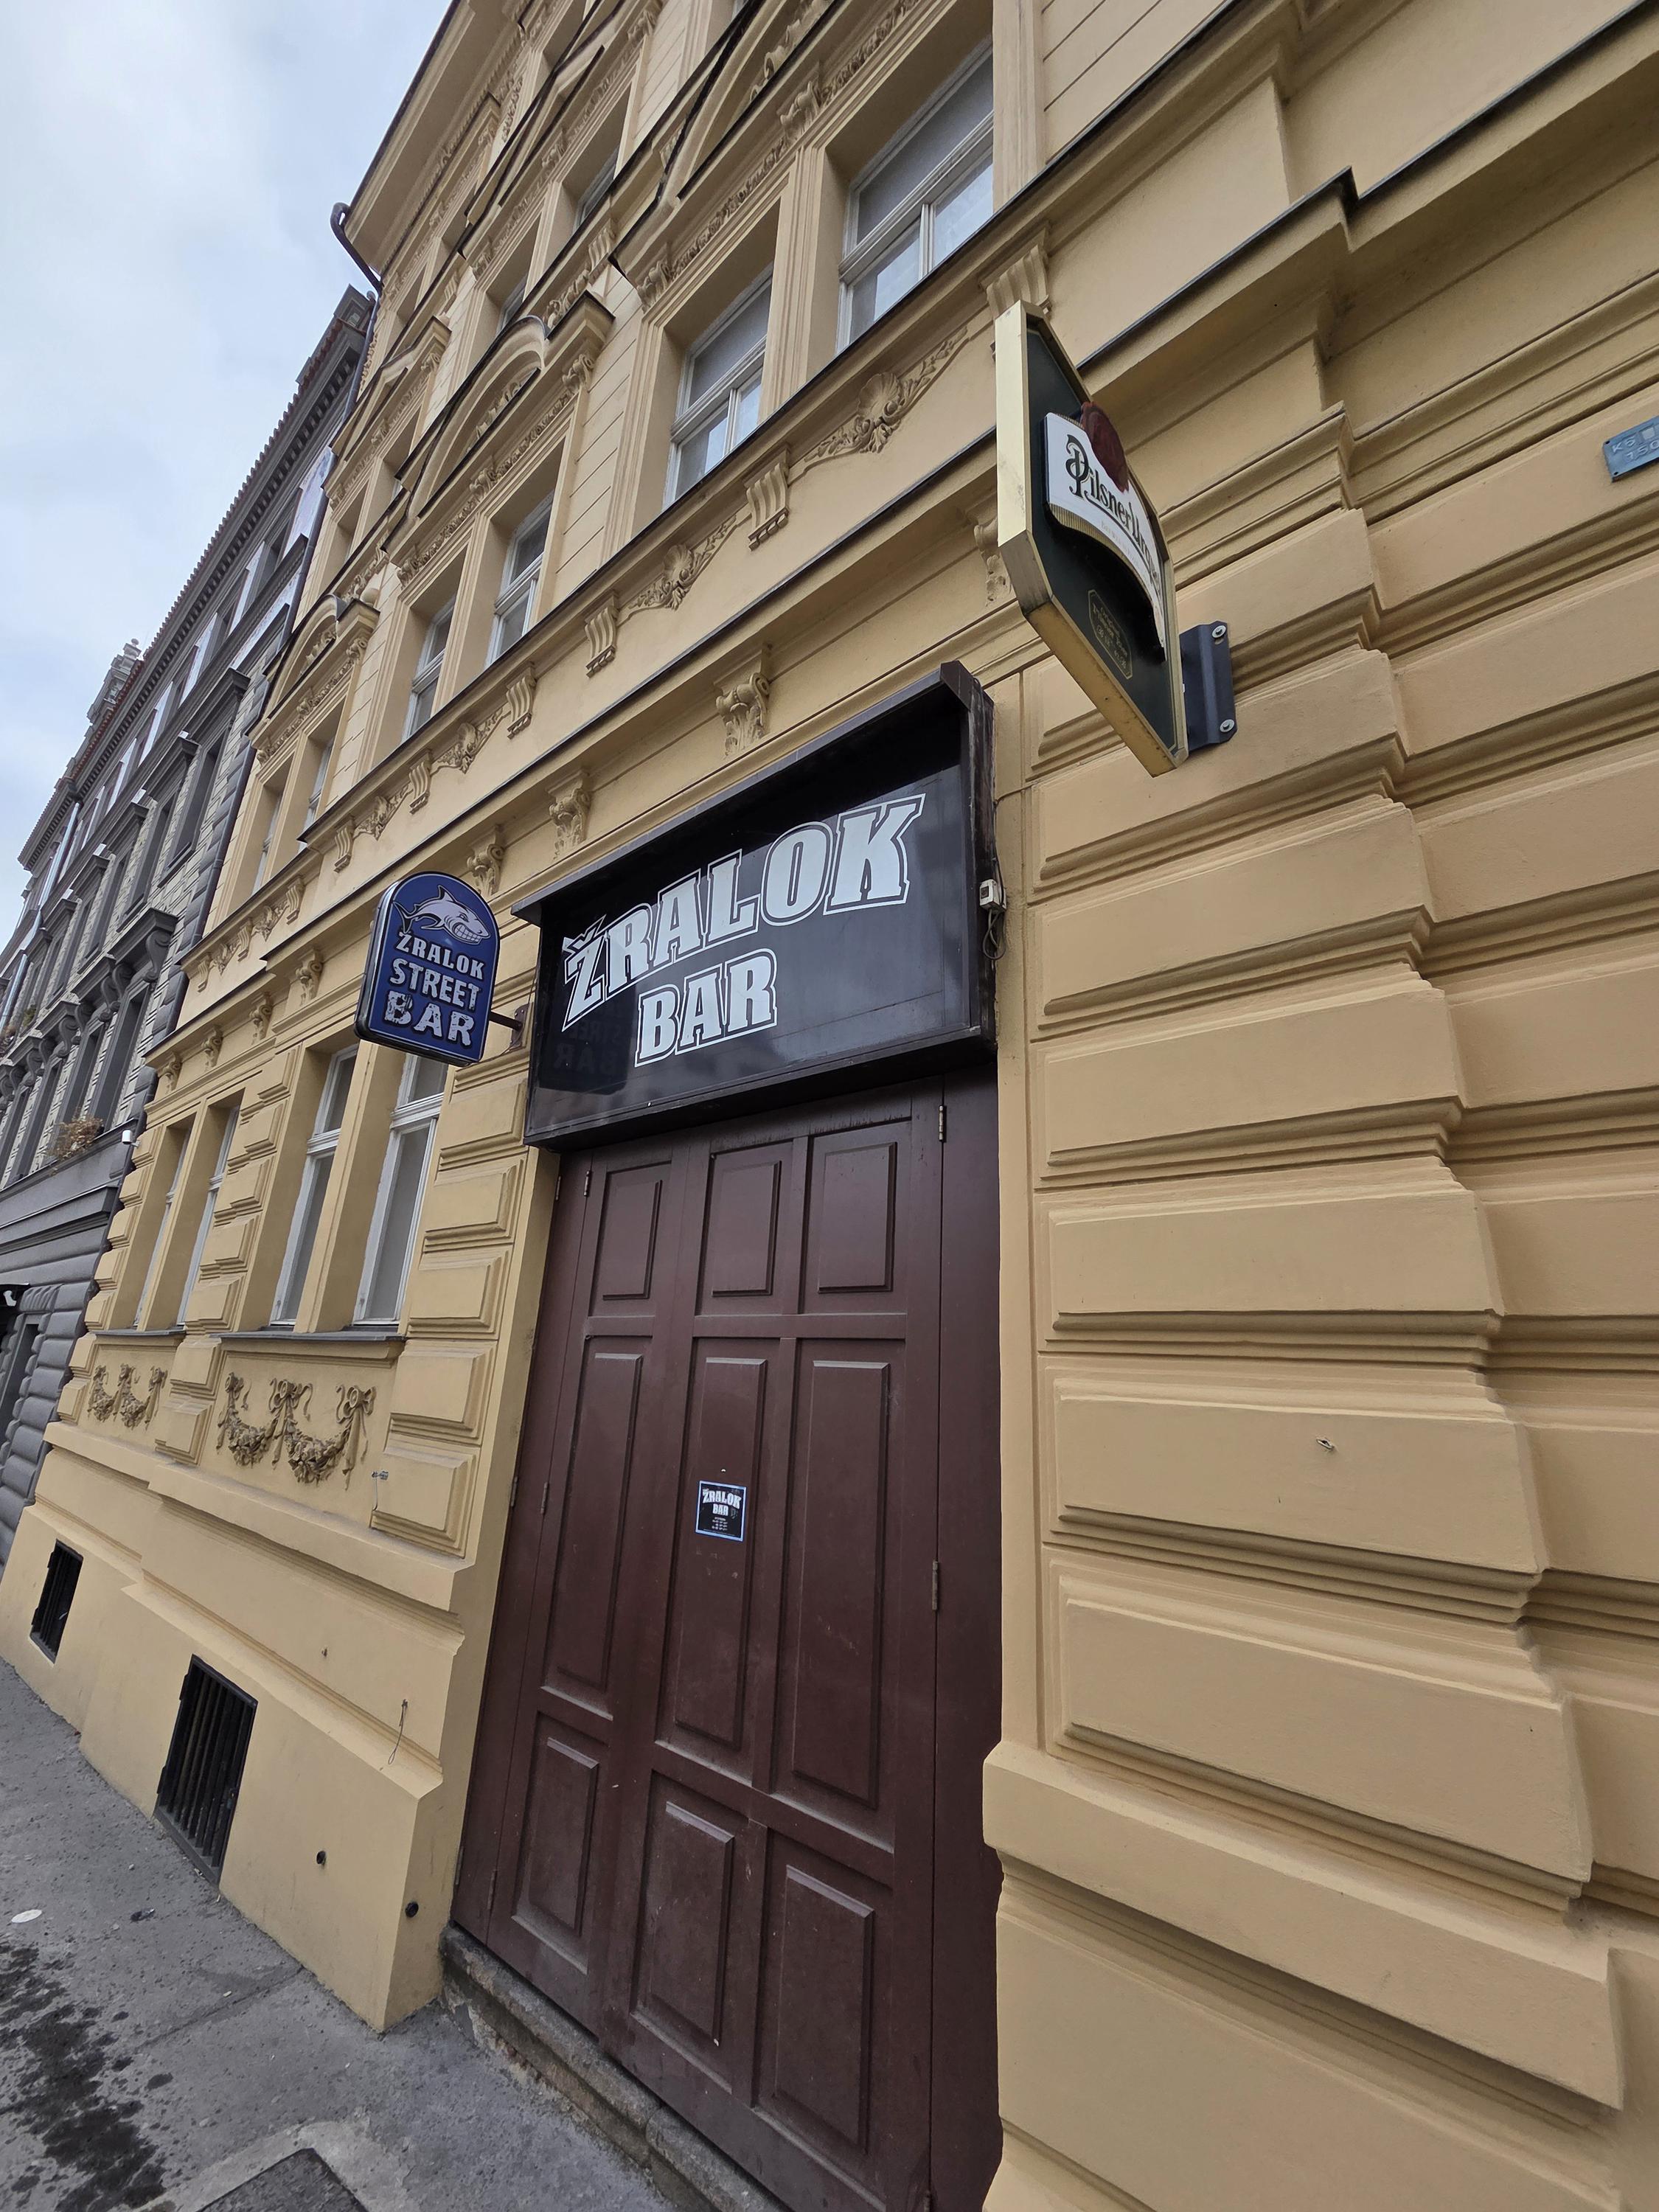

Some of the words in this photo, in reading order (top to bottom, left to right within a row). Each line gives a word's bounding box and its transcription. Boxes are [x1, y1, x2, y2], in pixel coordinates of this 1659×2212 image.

[1065, 434, 1131, 530] Pilsner
[562, 793, 926, 1032] ŽRALOK
[396, 931, 485, 980] ŽRALOK
[389, 958, 481, 1010] STREET
[635, 947, 777, 1068] BAR
[384, 990, 475, 1046] BAR
[702, 1488, 742, 1509] ŽRALOK
[712, 1503, 729, 1517] BAR
